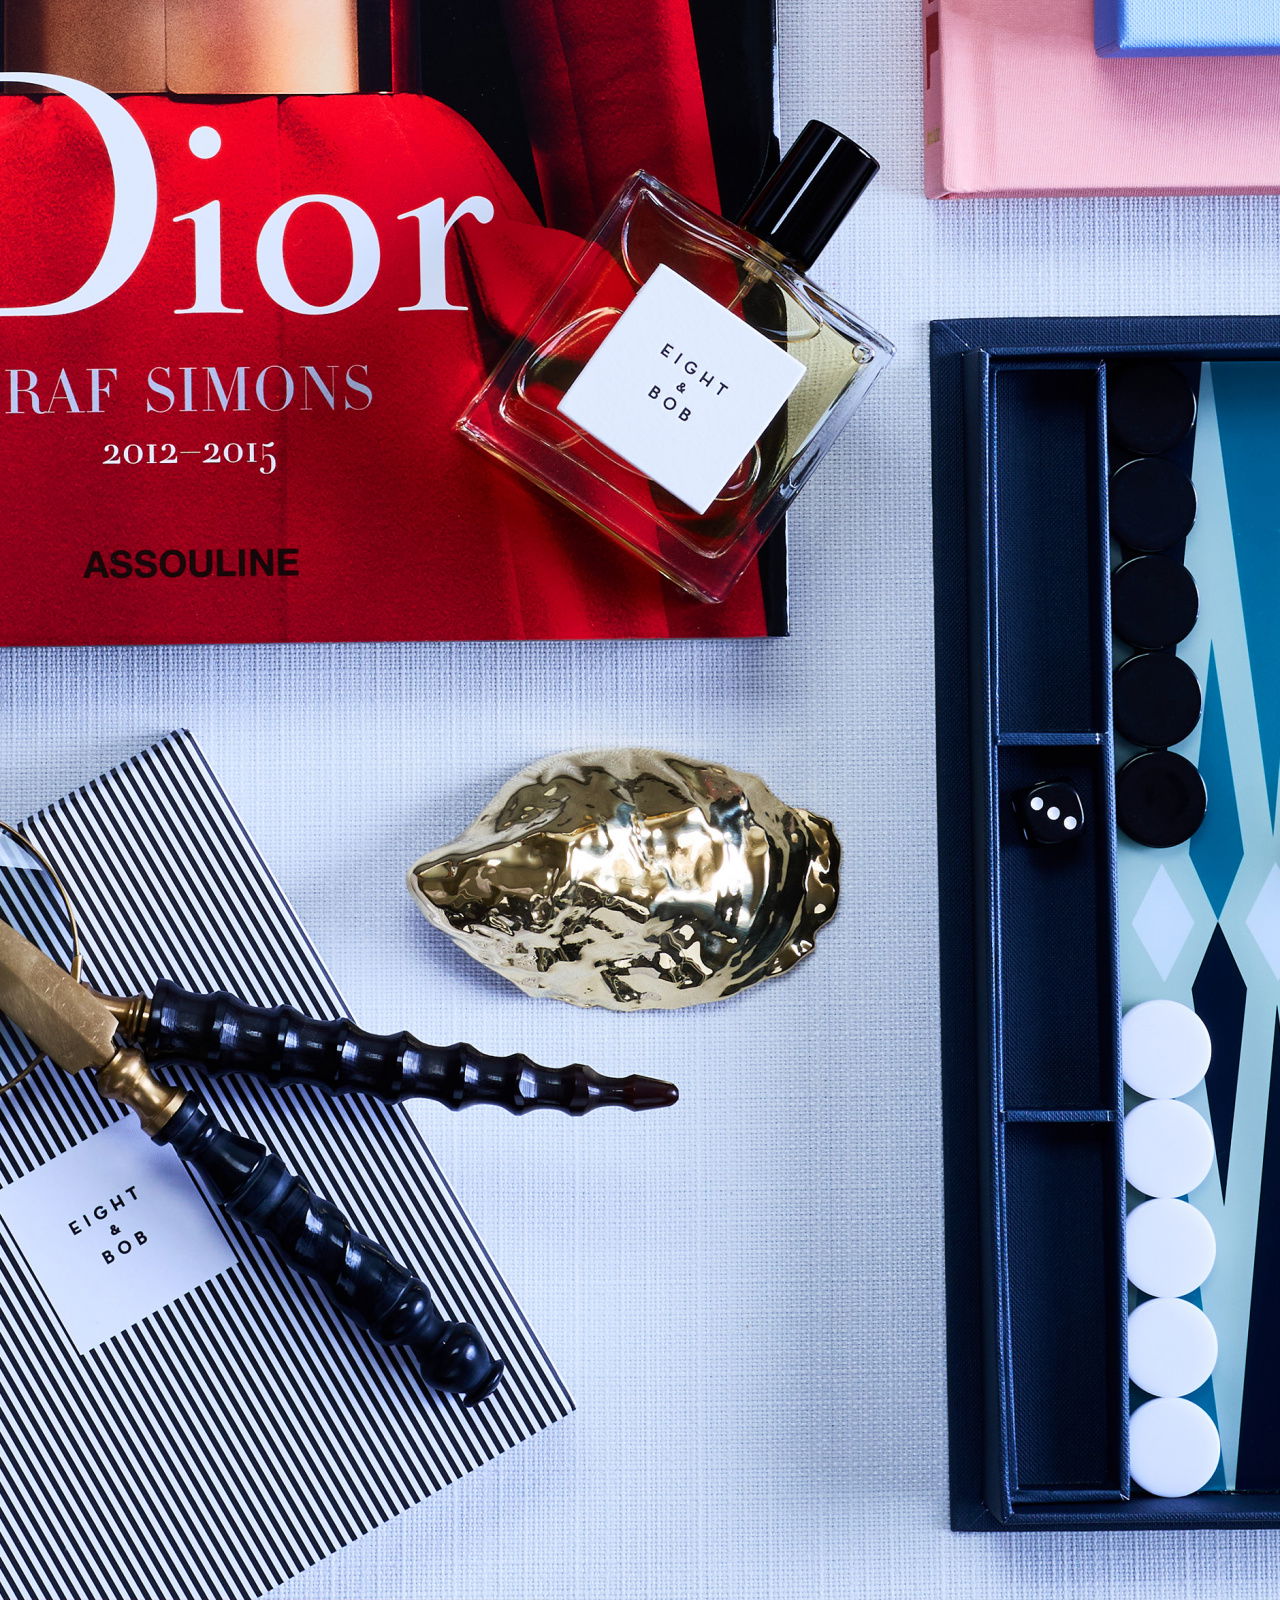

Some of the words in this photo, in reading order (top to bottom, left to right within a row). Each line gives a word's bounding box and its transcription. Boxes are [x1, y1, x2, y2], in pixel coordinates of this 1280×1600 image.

[660, 343, 729, 396] EIGHT
[5, 368, 118, 415] RAF
[147, 364, 374, 414] SIMONS
[648, 385, 692, 422] BOB
[676, 382, 686, 394] &
[83, 548, 299, 579] ASSOULINE
[68, 1185, 138, 1236] EIGHT
[101, 1230, 149, 1265] BOB
[109, 1224, 122, 1236] &
